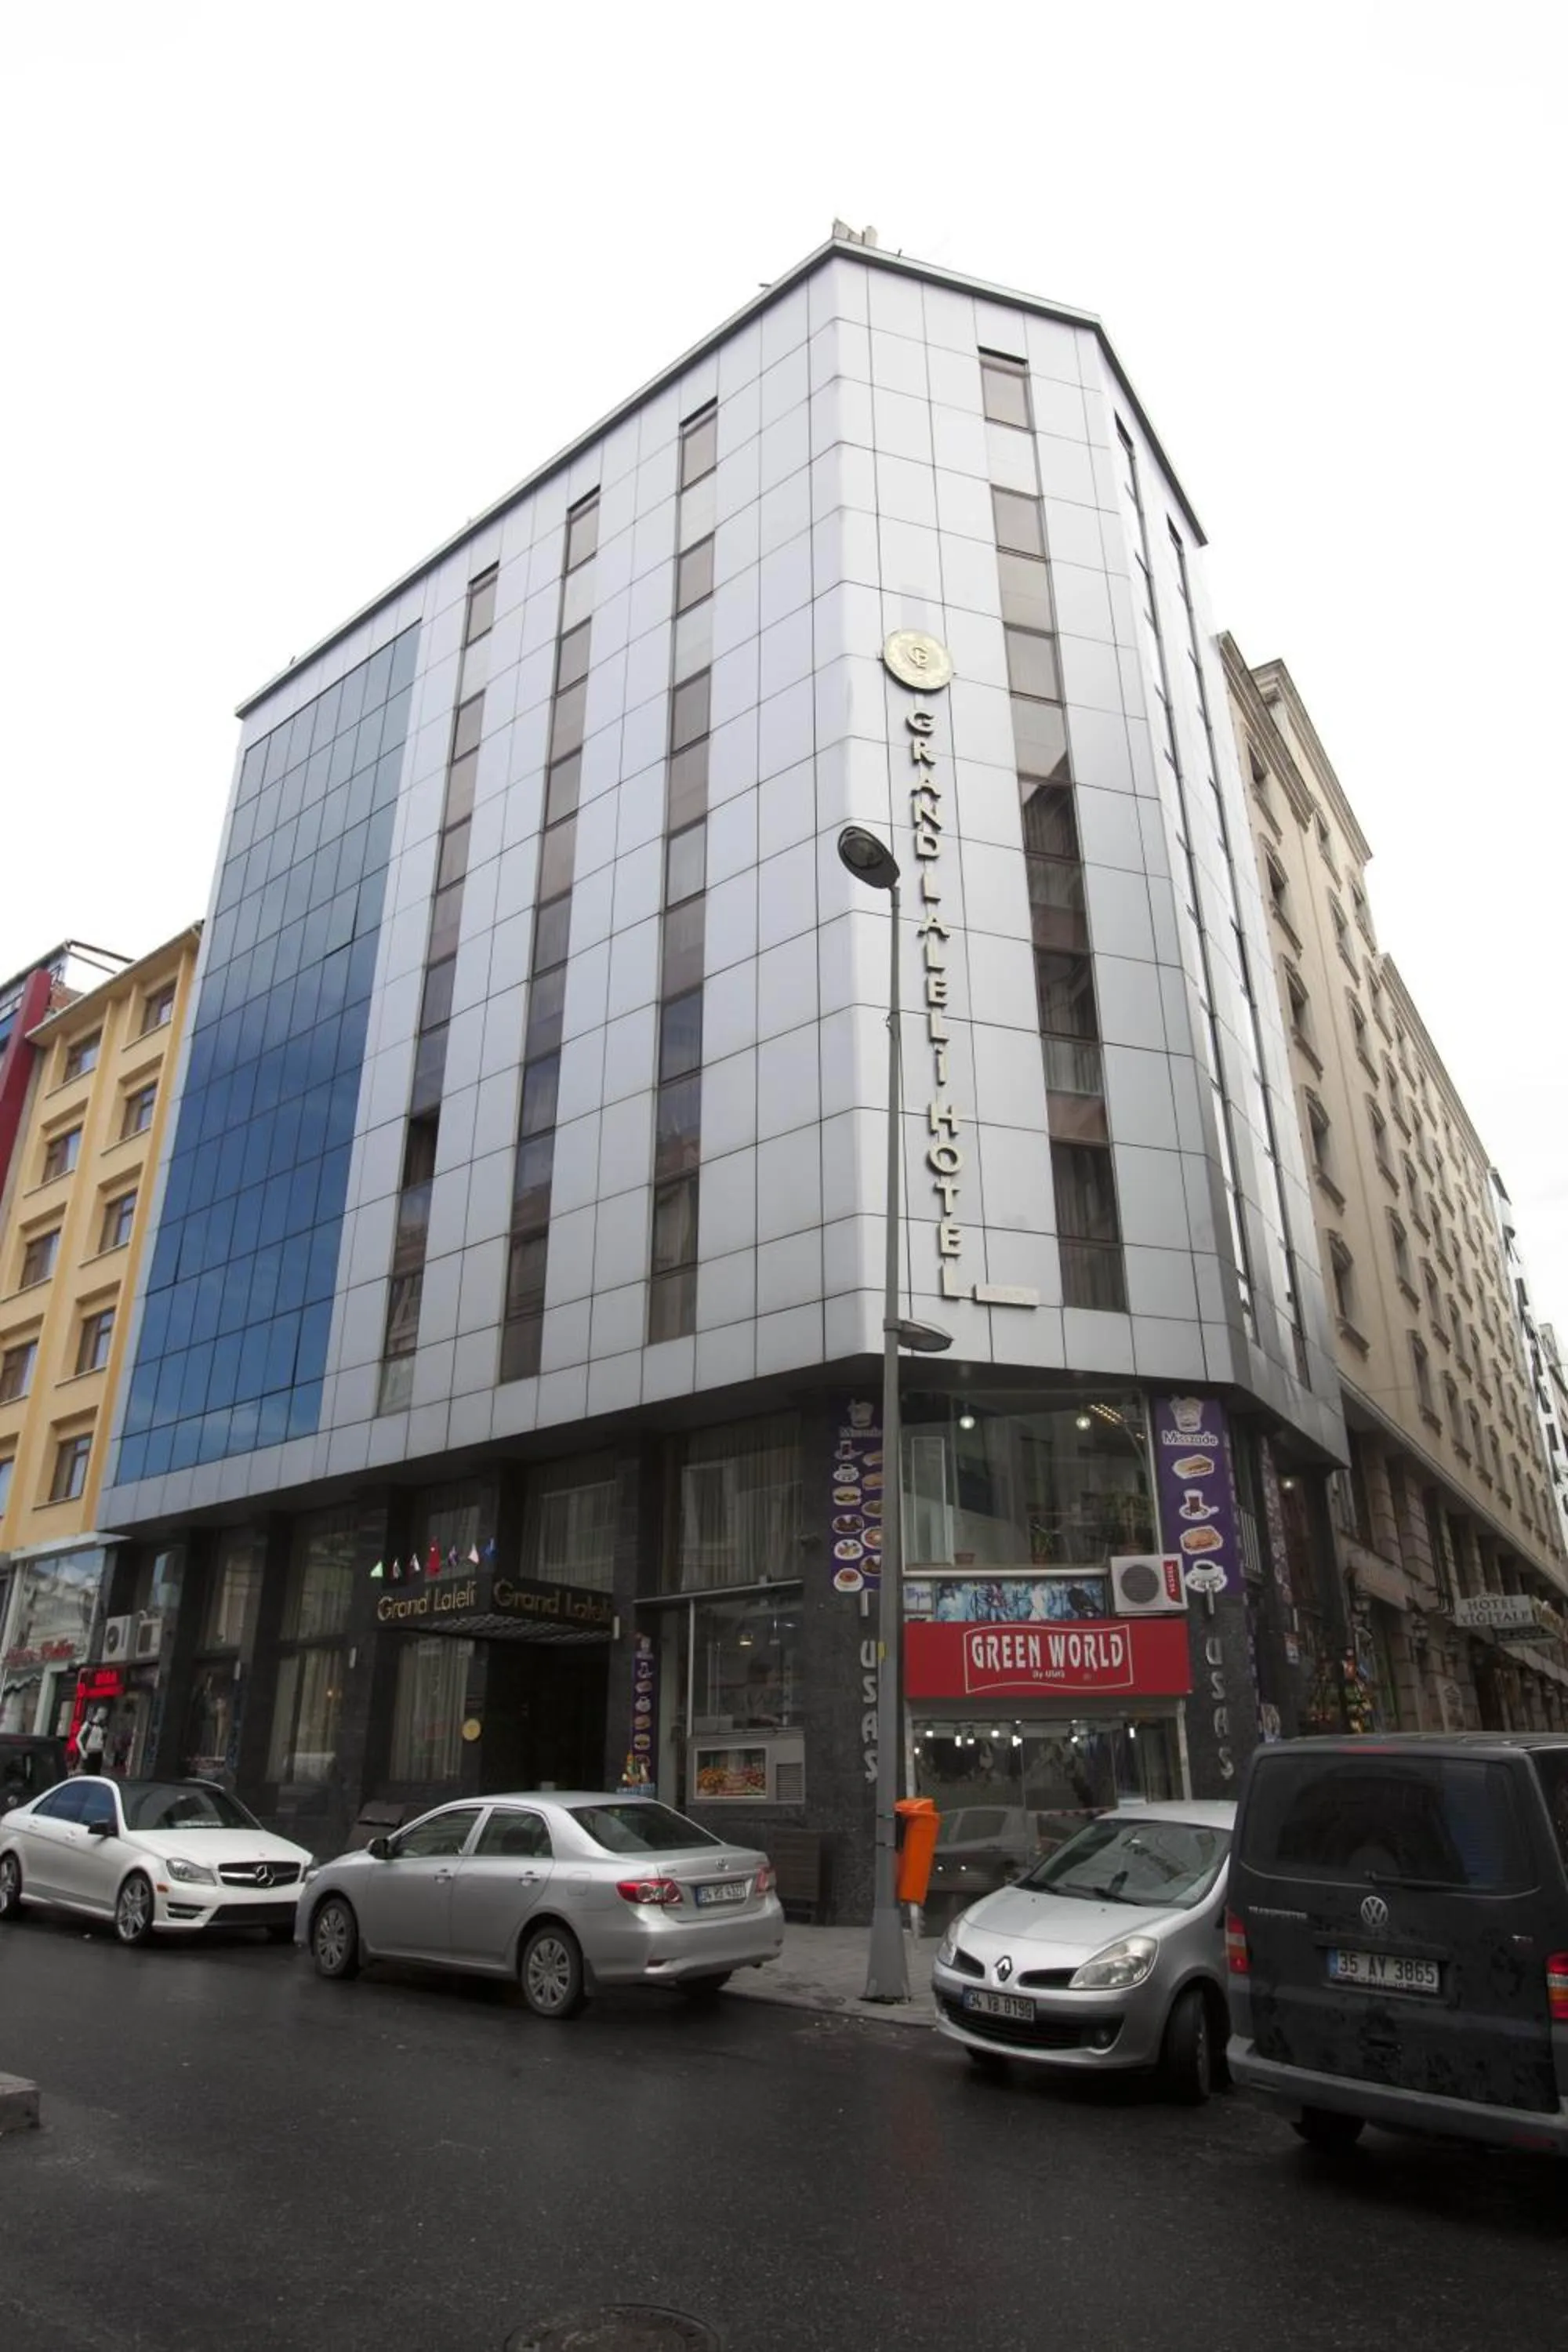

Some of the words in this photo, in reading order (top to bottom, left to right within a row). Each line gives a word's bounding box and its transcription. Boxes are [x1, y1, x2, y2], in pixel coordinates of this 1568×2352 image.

[906, 709, 942, 860] GRAND
[927, 1102, 963, 1301] HOTEL
[377, 1593, 428, 1621] Grand
[493, 1577, 561, 1615] Grand
[1468, 1597, 1516, 1610] HOTEL
[971, 1634, 1041, 1672] GREEN
[1048, 1633, 1123, 1671] WORLD
[1340, 1952, 1358, 1973] 35
[1369, 1956, 1386, 1977] AY
[1394, 1960, 1435, 1984] 3865
